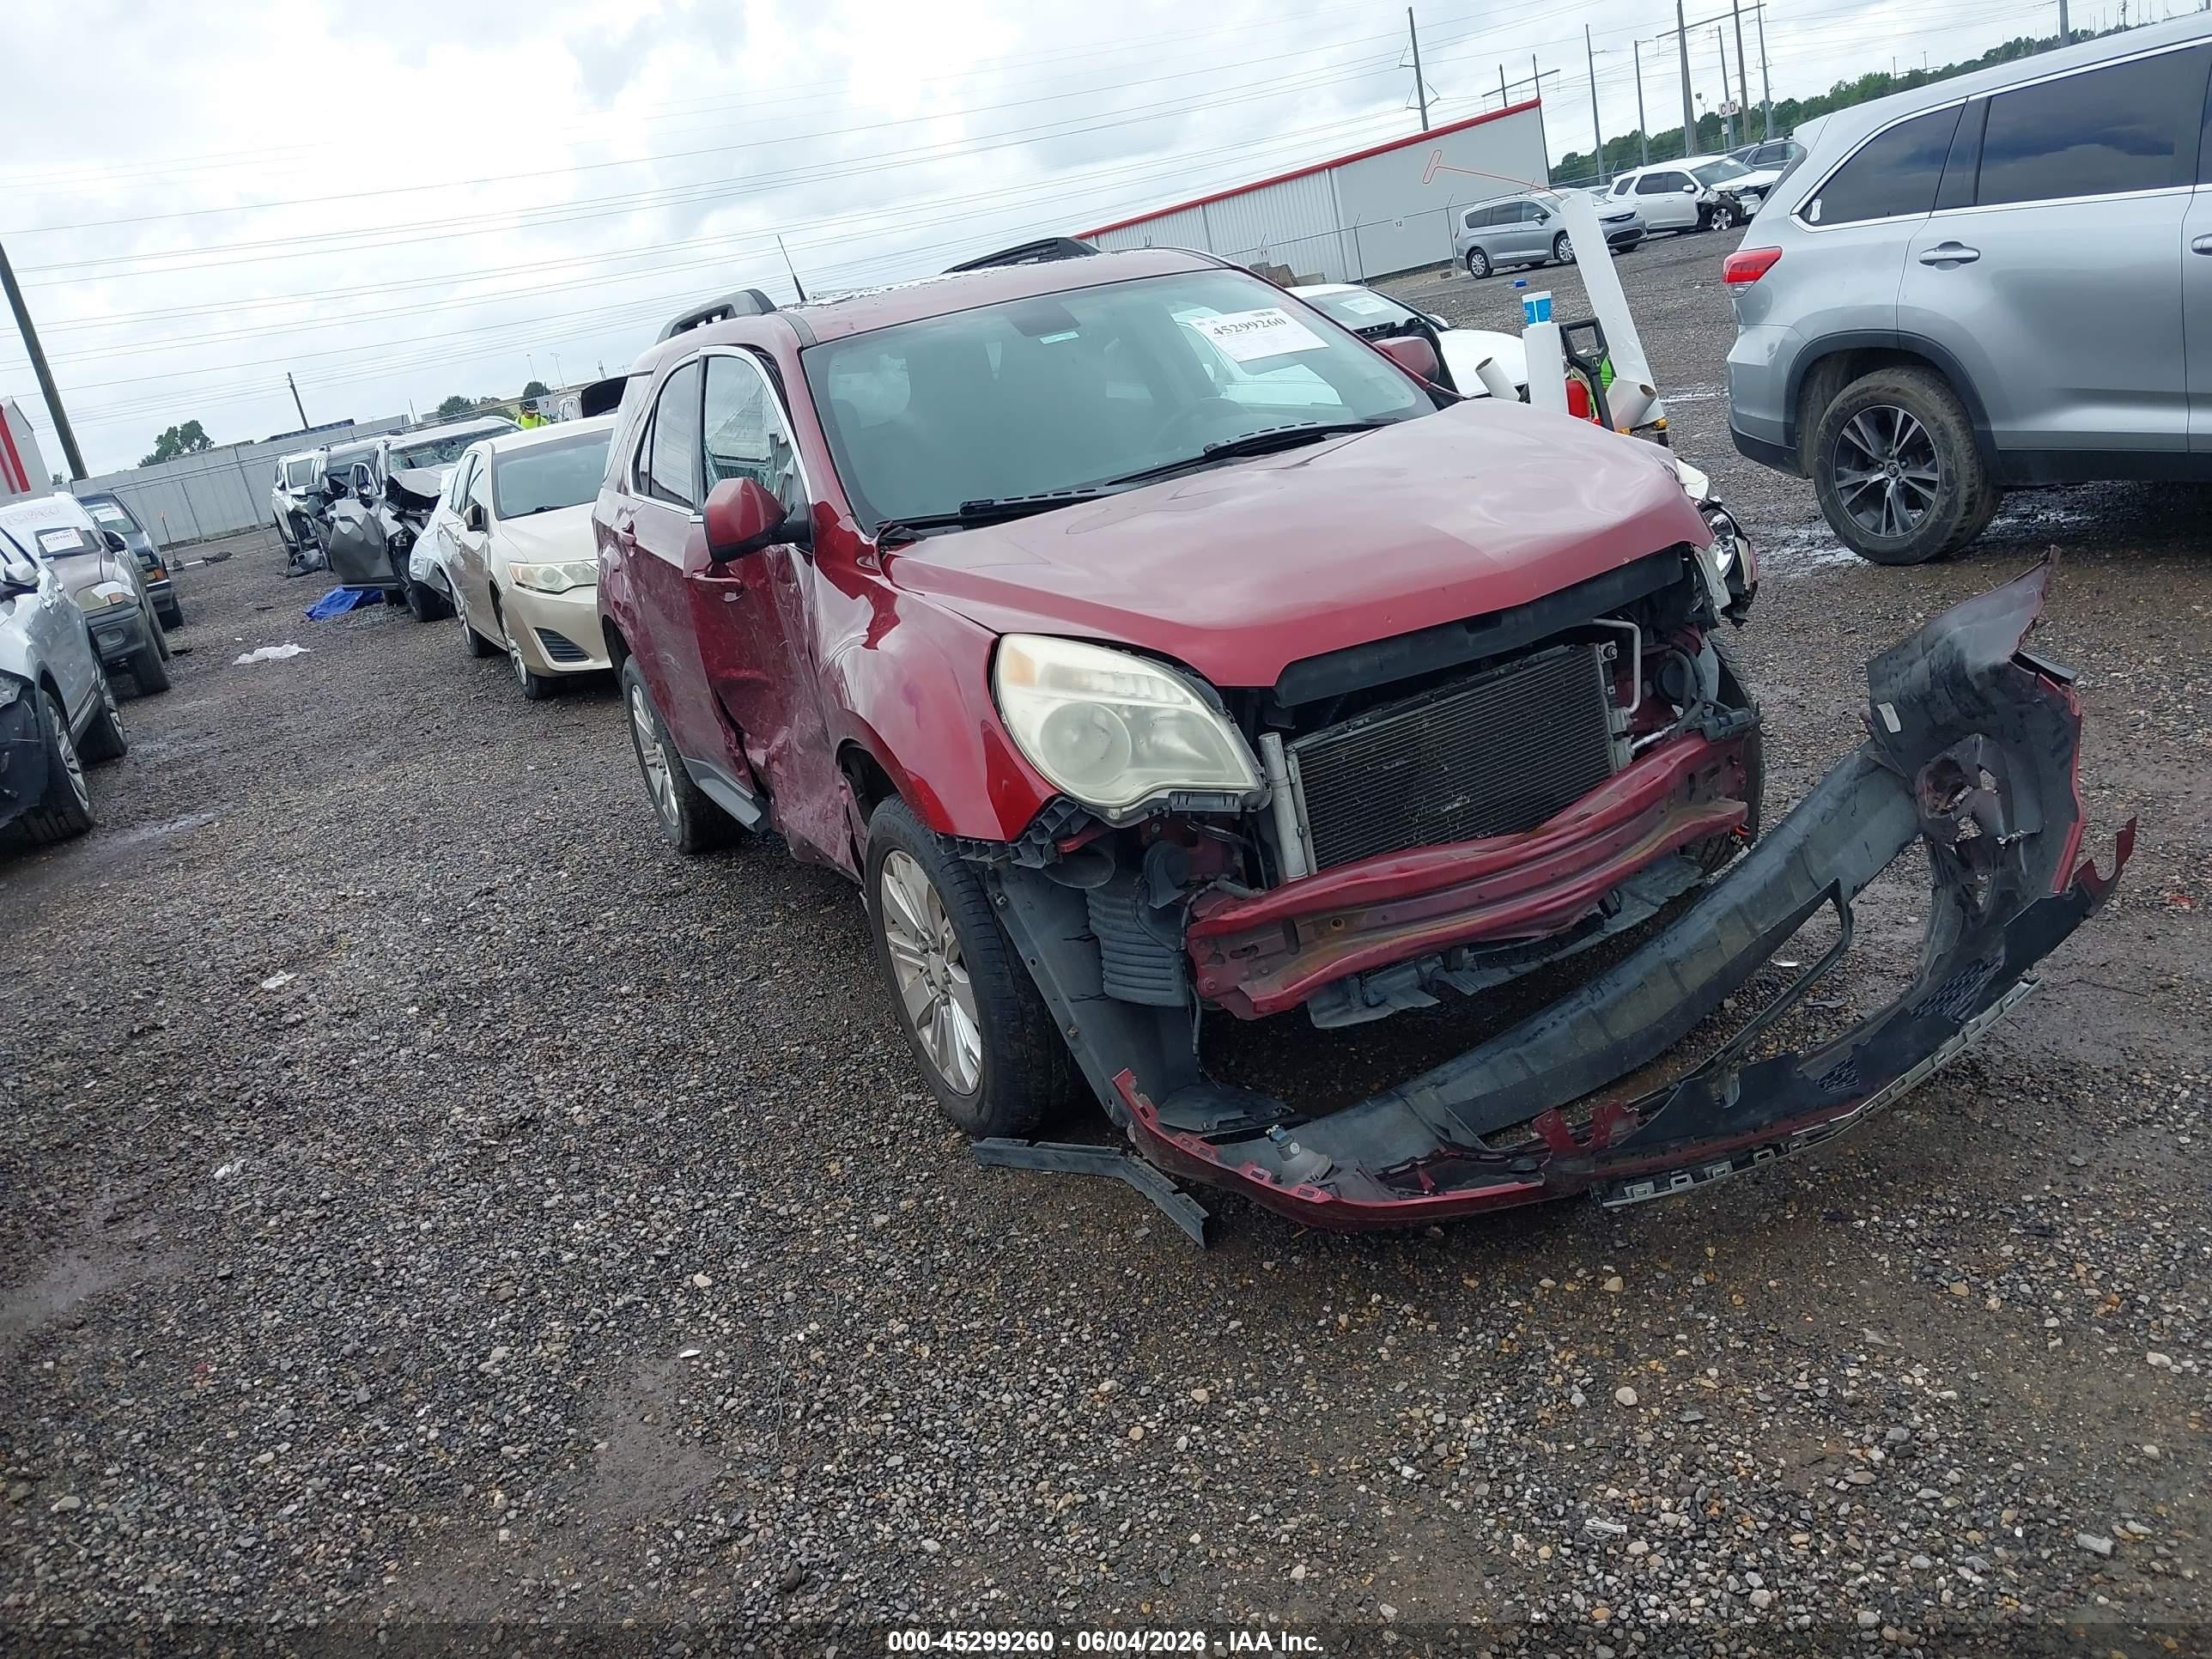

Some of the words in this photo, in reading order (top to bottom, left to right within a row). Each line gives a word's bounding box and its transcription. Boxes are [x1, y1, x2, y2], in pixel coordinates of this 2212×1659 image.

[1720, 104, 1727, 115] C
[1729, 101, 1736, 112] D
[1213, 317, 1287, 336] 45299260
